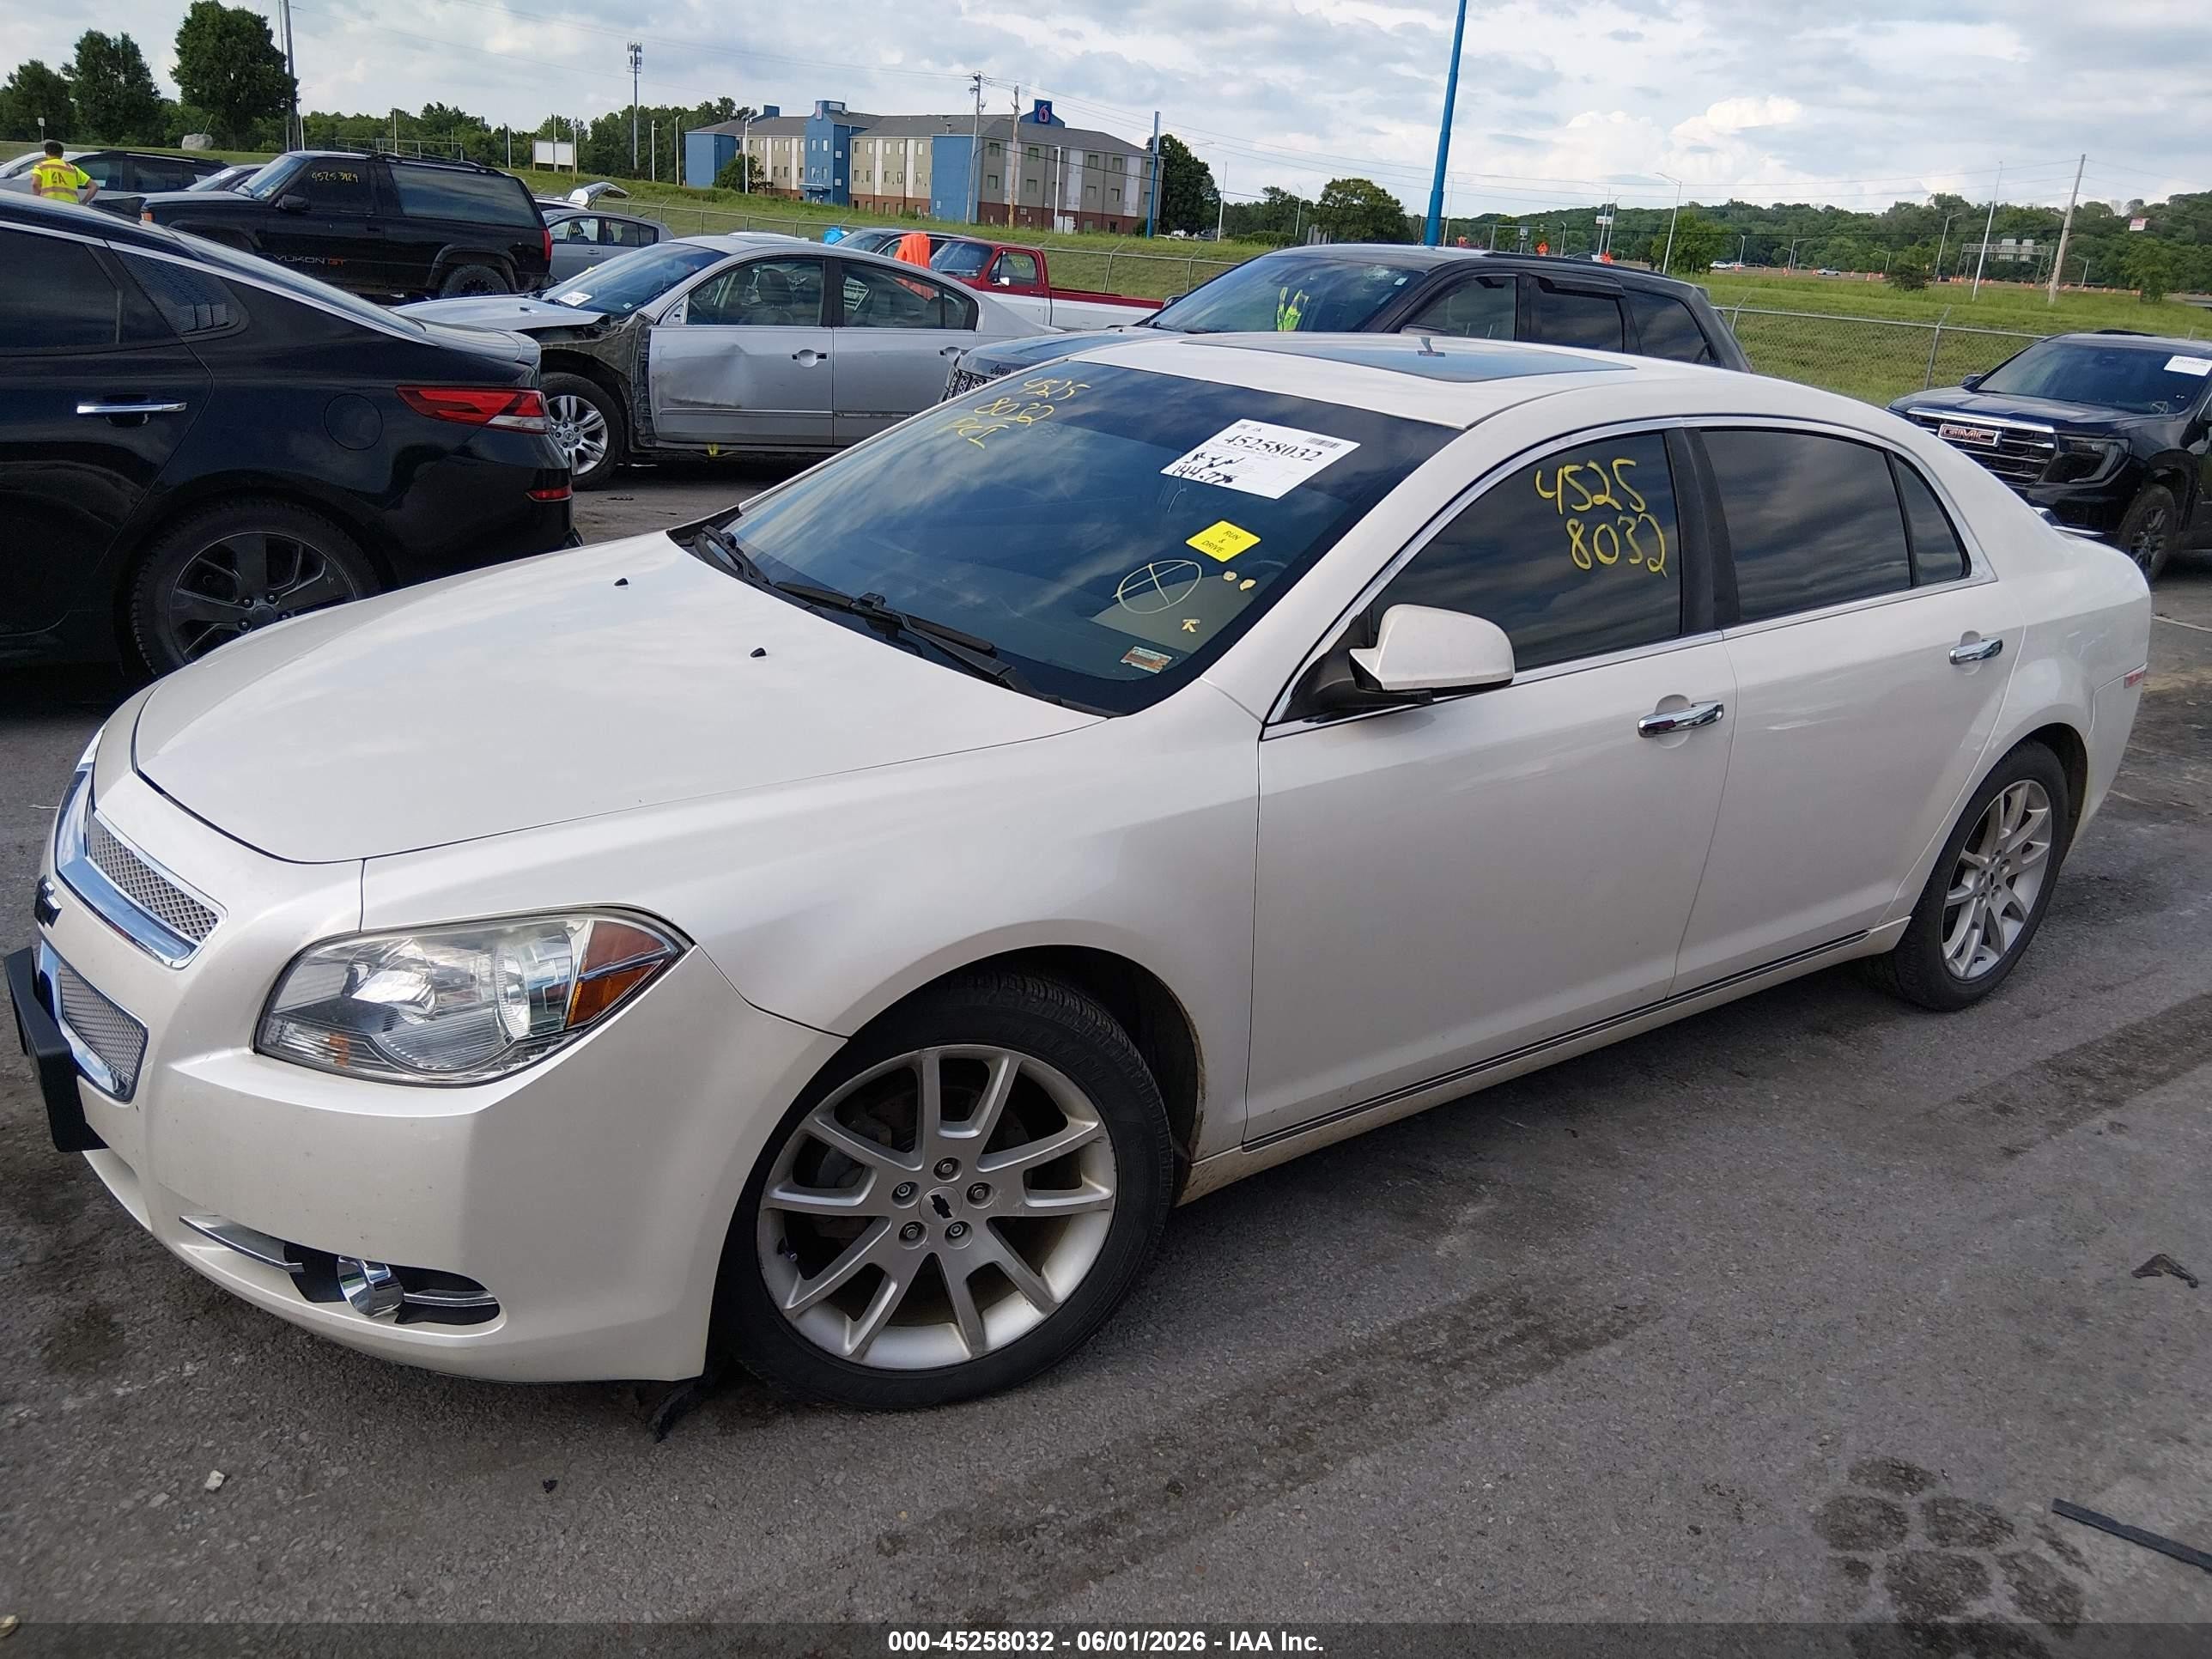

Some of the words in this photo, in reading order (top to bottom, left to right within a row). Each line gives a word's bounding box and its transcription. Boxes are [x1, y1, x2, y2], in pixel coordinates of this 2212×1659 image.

[1039, 105, 1048, 123] 6
[274, 254, 325, 264] YUKON
[1941, 426, 1994, 443] GMC
[1224, 434, 1323, 462] 45258032
[1535, 459, 1646, 514] 4525
[1224, 530, 1242, 540] RUN
[1201, 540, 1224, 553] DRIVE
[1566, 513, 1668, 578] 8032
